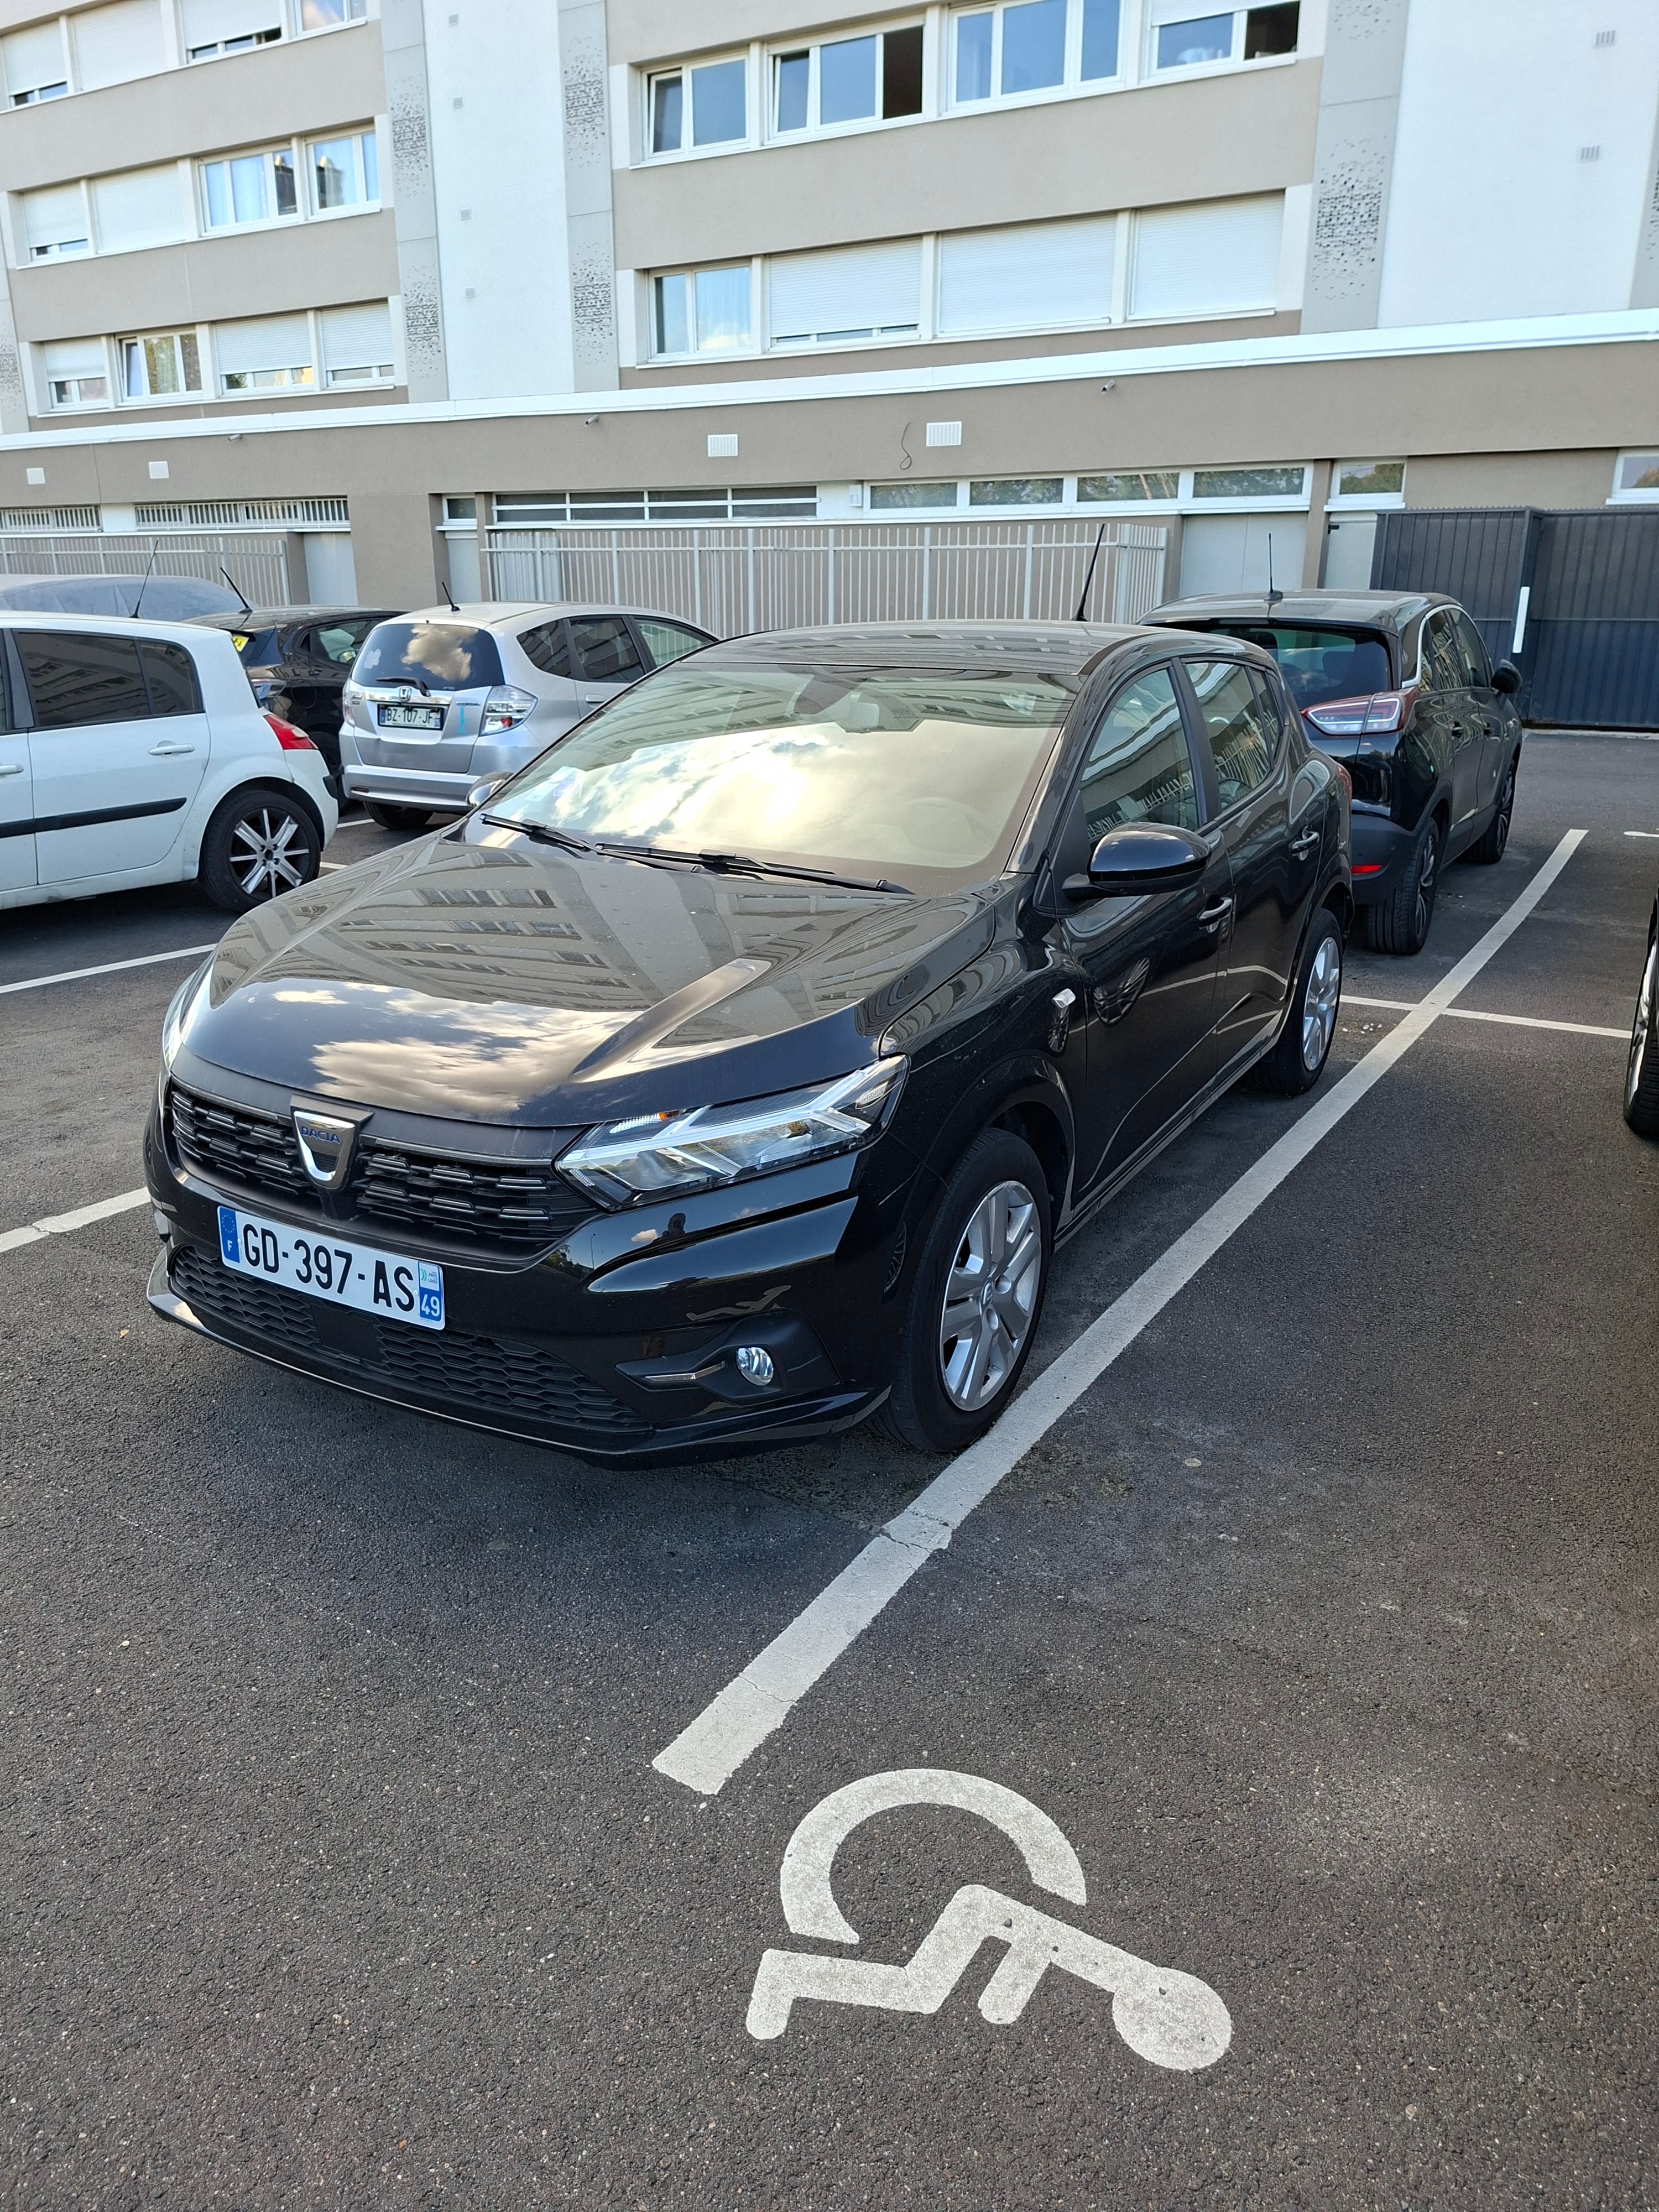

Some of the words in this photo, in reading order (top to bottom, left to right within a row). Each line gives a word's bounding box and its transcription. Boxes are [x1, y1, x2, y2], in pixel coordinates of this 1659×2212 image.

[387, 708, 433, 724] BZ-107-JF
[300, 1126, 341, 1144] DACIA
[227, 1239, 233, 1252] F
[243, 1224, 415, 1312] GD-397-AS
[421, 1294, 440, 1317] 49
